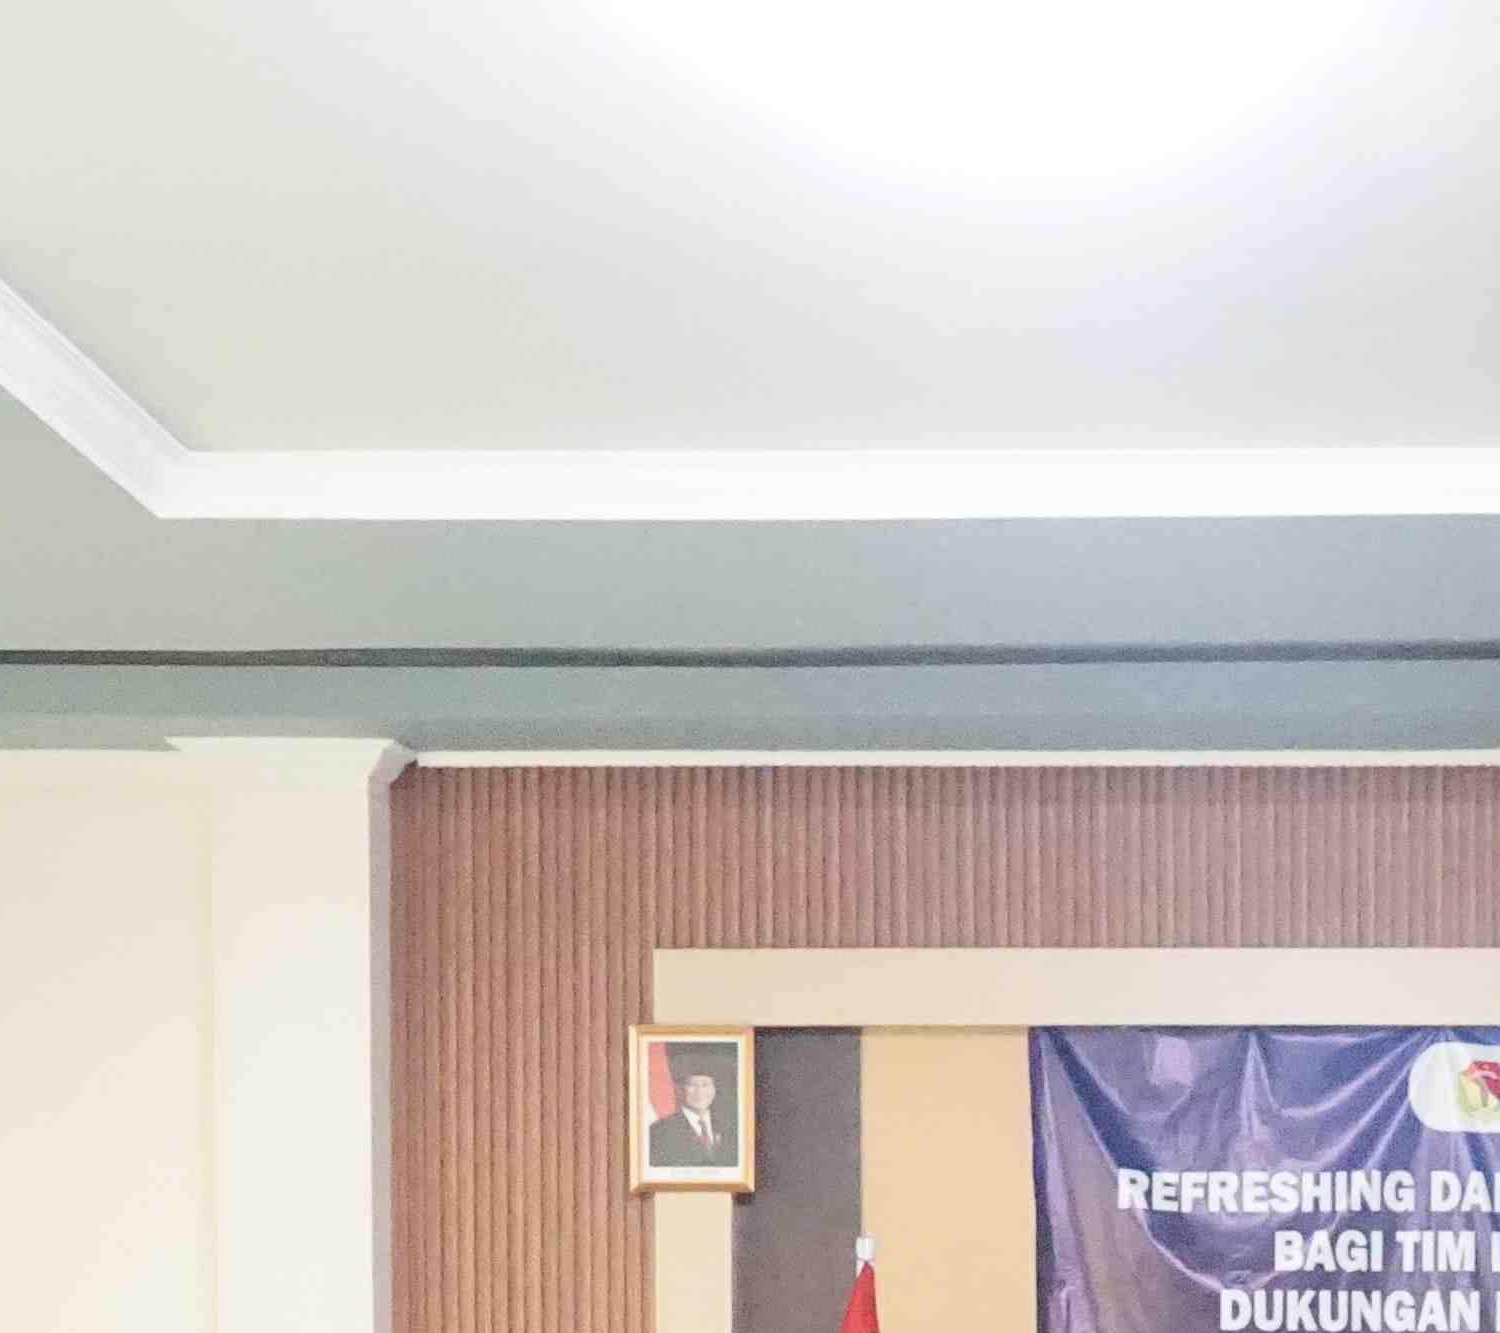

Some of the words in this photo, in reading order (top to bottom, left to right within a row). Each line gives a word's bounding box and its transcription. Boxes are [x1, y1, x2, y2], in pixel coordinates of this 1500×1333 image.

[1117, 1169, 1416, 1213] REFRESHING
[1274, 1229, 1383, 1272] BAGI
[1395, 1230, 1476, 1272] TIM
[1220, 1289, 1480, 1332] DUKUNGAN
